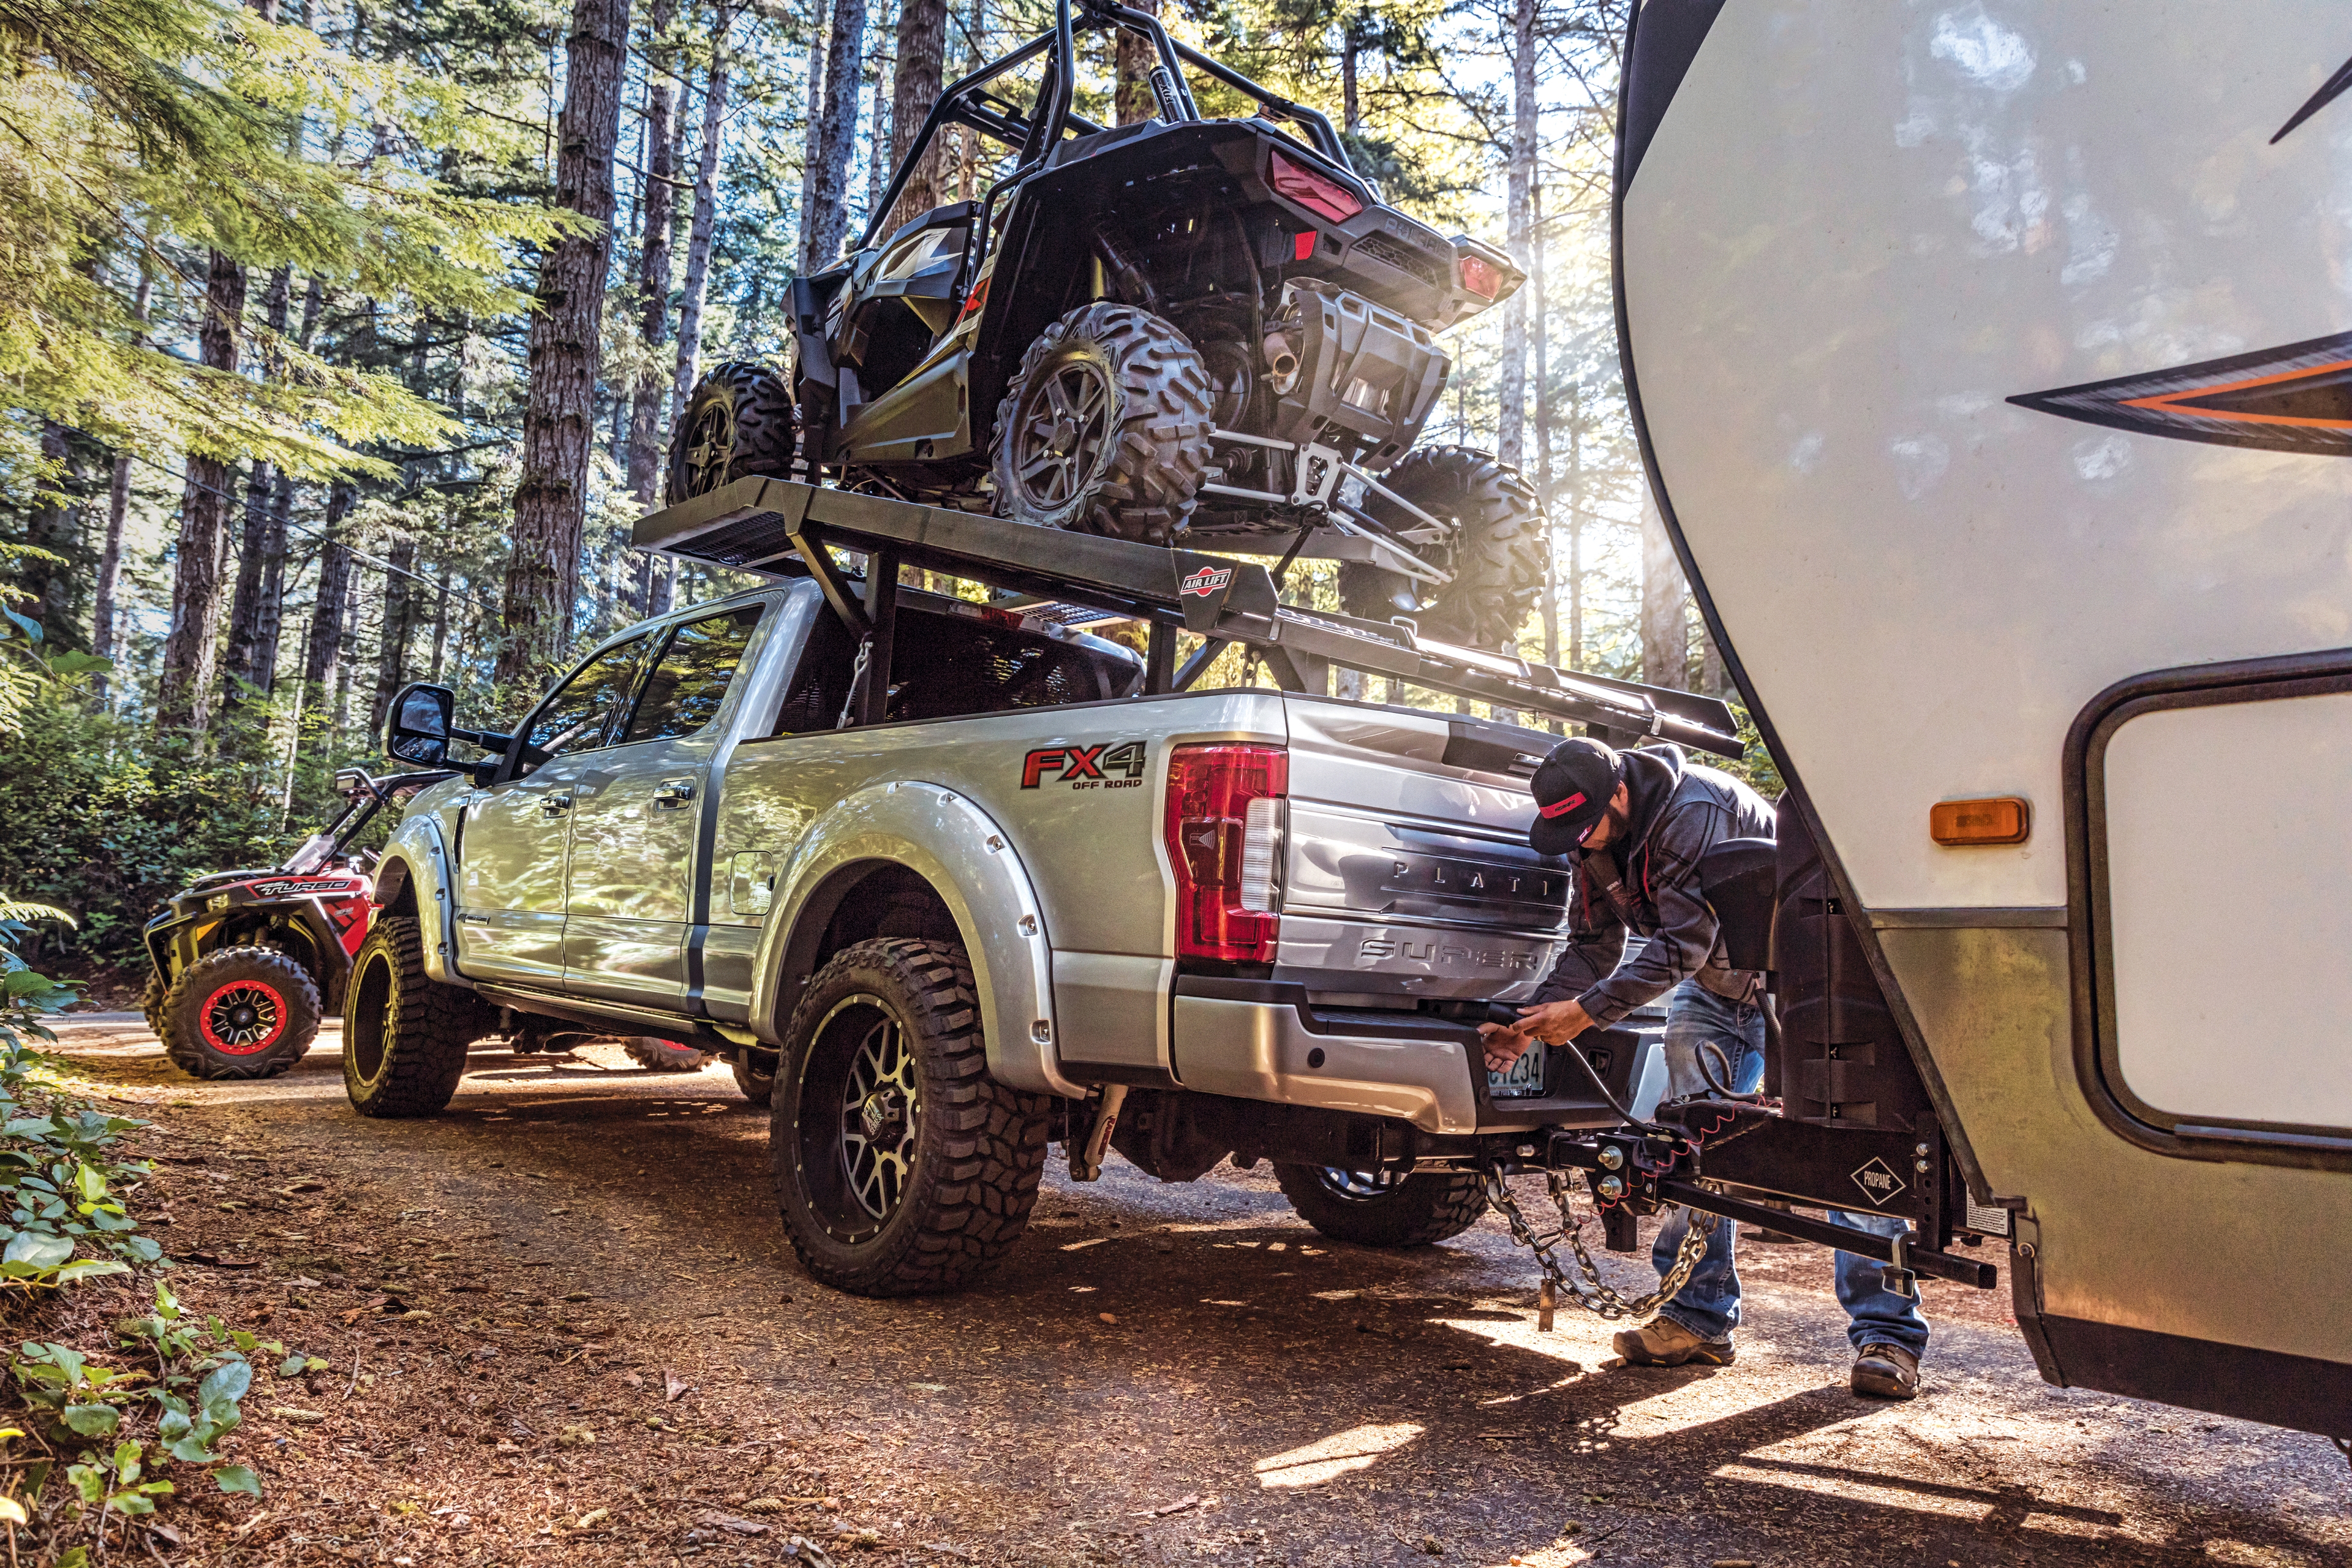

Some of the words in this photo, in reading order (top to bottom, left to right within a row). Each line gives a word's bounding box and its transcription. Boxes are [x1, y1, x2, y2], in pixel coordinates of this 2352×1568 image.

[1184, 578, 1202, 590] AIR
[1204, 574, 1227, 587] LIFT
[1020, 740, 1147, 790] FX4
[1072, 781, 1099, 790] OFF
[1104, 778, 1142, 789] ROAD
[261, 880, 352, 895] TURBO
[1360, 939, 1538, 970] SUPER
[1864, 1170, 1891, 1190] PROPANE
